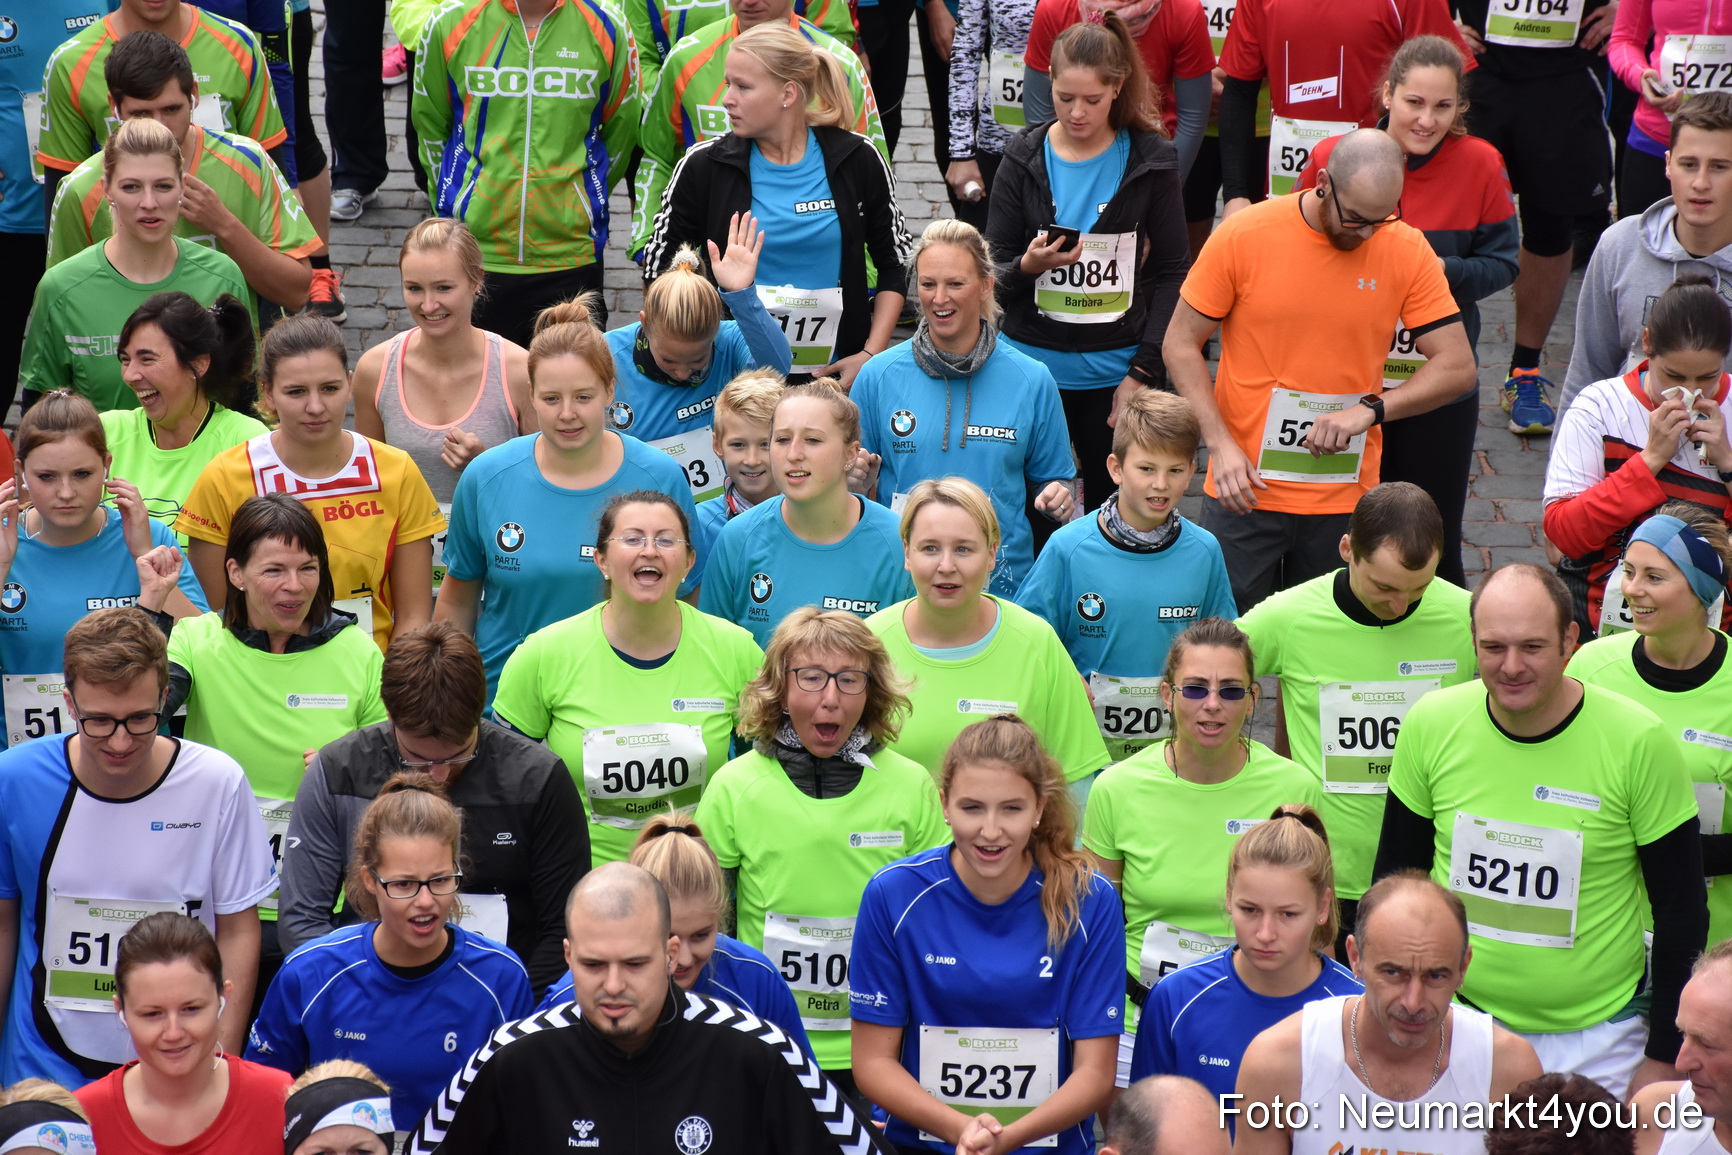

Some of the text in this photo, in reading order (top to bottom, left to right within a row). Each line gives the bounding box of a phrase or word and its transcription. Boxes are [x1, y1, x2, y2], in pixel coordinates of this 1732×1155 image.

[1513, 21, 1552, 34] Andreas
[0, 45, 23, 54] ARTL
[1672, 62, 1732, 89] 5272
[465, 66, 598, 99] BOCK
[1002, 78, 1024, 103] 52
[1301, 85, 1323, 96] DEHN
[1299, 128, 1329, 137] BOCK
[1281, 146, 1309, 172] 52
[1081, 241, 1108, 250] OCK
[1050, 259, 1119, 288] 5084
[785, 297, 818, 307] BOCK
[1064, 296, 1103, 308] Barbara
[770, 315, 826, 341] 117
[1383, 363, 1416, 374] ronika
[1309, 401, 1343, 410] BOCK
[967, 425, 1017, 440] BOCK
[1278, 419, 1315, 446] 52
[322, 500, 384, 522] BÖGL
[495, 555, 520, 566] PARTL
[495, 563, 520, 571] Neumarkt
[823, 596, 880, 613] BOCK
[749, 607, 770, 616] PARTL
[1158, 605, 1200, 619] BOCK
[0, 617, 27, 626] ARTL
[748, 614, 769, 622] Neumarkt
[1079, 624, 1107, 633] PARTL
[49, 684, 66, 693] BO
[1131, 686, 1160, 695] BOC
[1364, 691, 1405, 702] BOCK
[25, 706, 62, 739] 51
[1103, 705, 1171, 734] 520
[1338, 716, 1400, 750] 506
[628, 734, 669, 745] BOCK
[1124, 744, 1147, 754] Pas
[602, 756, 689, 794] 5040
[625, 799, 669, 813] Claudia
[261, 807, 292, 819] OCK
[1498, 832, 1543, 849] BOCK
[1467, 852, 1559, 900] 5210
[102, 908, 148, 920] BOCK
[811, 927, 851, 938] BOCK
[67, 931, 112, 966] 51
[935, 956, 956, 965] JAKO
[780, 950, 848, 987] 510
[1039, 956, 1053, 978] 2
[94, 979, 118, 992] Luk
[807, 997, 839, 1011] Petra
[344, 1031, 366, 1041] JAKO
[444, 1031, 457, 1053] 6
[972, 1038, 1018, 1049] BOCK
[1208, 1057, 1230, 1067] JAKO
[940, 1062, 1036, 1100] 5237
[568, 1136, 599, 1147] hummel
